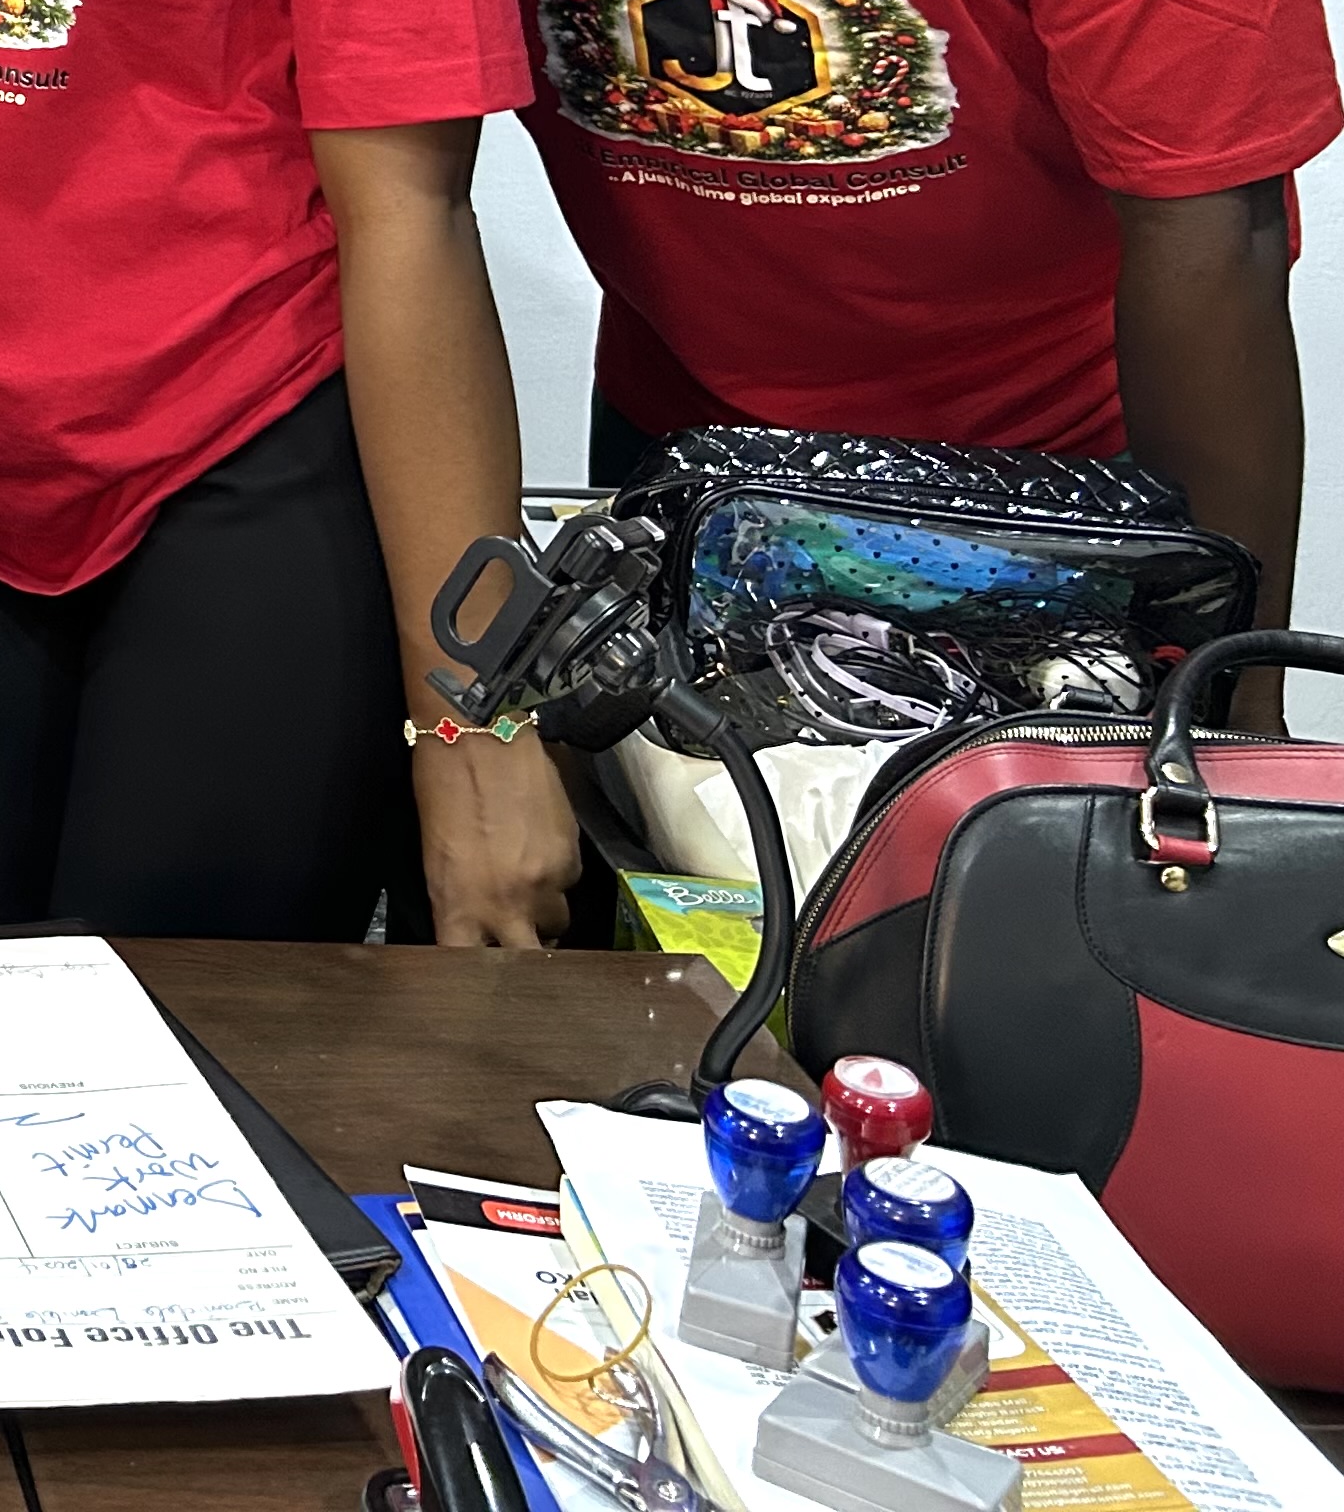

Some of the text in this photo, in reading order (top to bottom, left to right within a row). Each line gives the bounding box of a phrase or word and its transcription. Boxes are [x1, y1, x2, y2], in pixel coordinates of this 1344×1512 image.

[599, 151, 969, 191] Empirical Global Consult
[621, 171, 637, 183] A
[637, 171, 674, 187] just
[691, 183, 736, 202] time
[739, 189, 804, 207] global
[805, 183, 921, 208] experience
[663, 886, 757, 906] Belle
[17, 1080, 86, 1091] PREVIOUS
[31, 1123, 164, 1177] Permit
[45, 1178, 262, 1234] Denmark
[115, 1238, 179, 1250] SUBJECT
[237, 1280, 297, 1291] ADDRESS
[83, 1322, 219, 1348] Office
[228, 1317, 312, 1346] The
